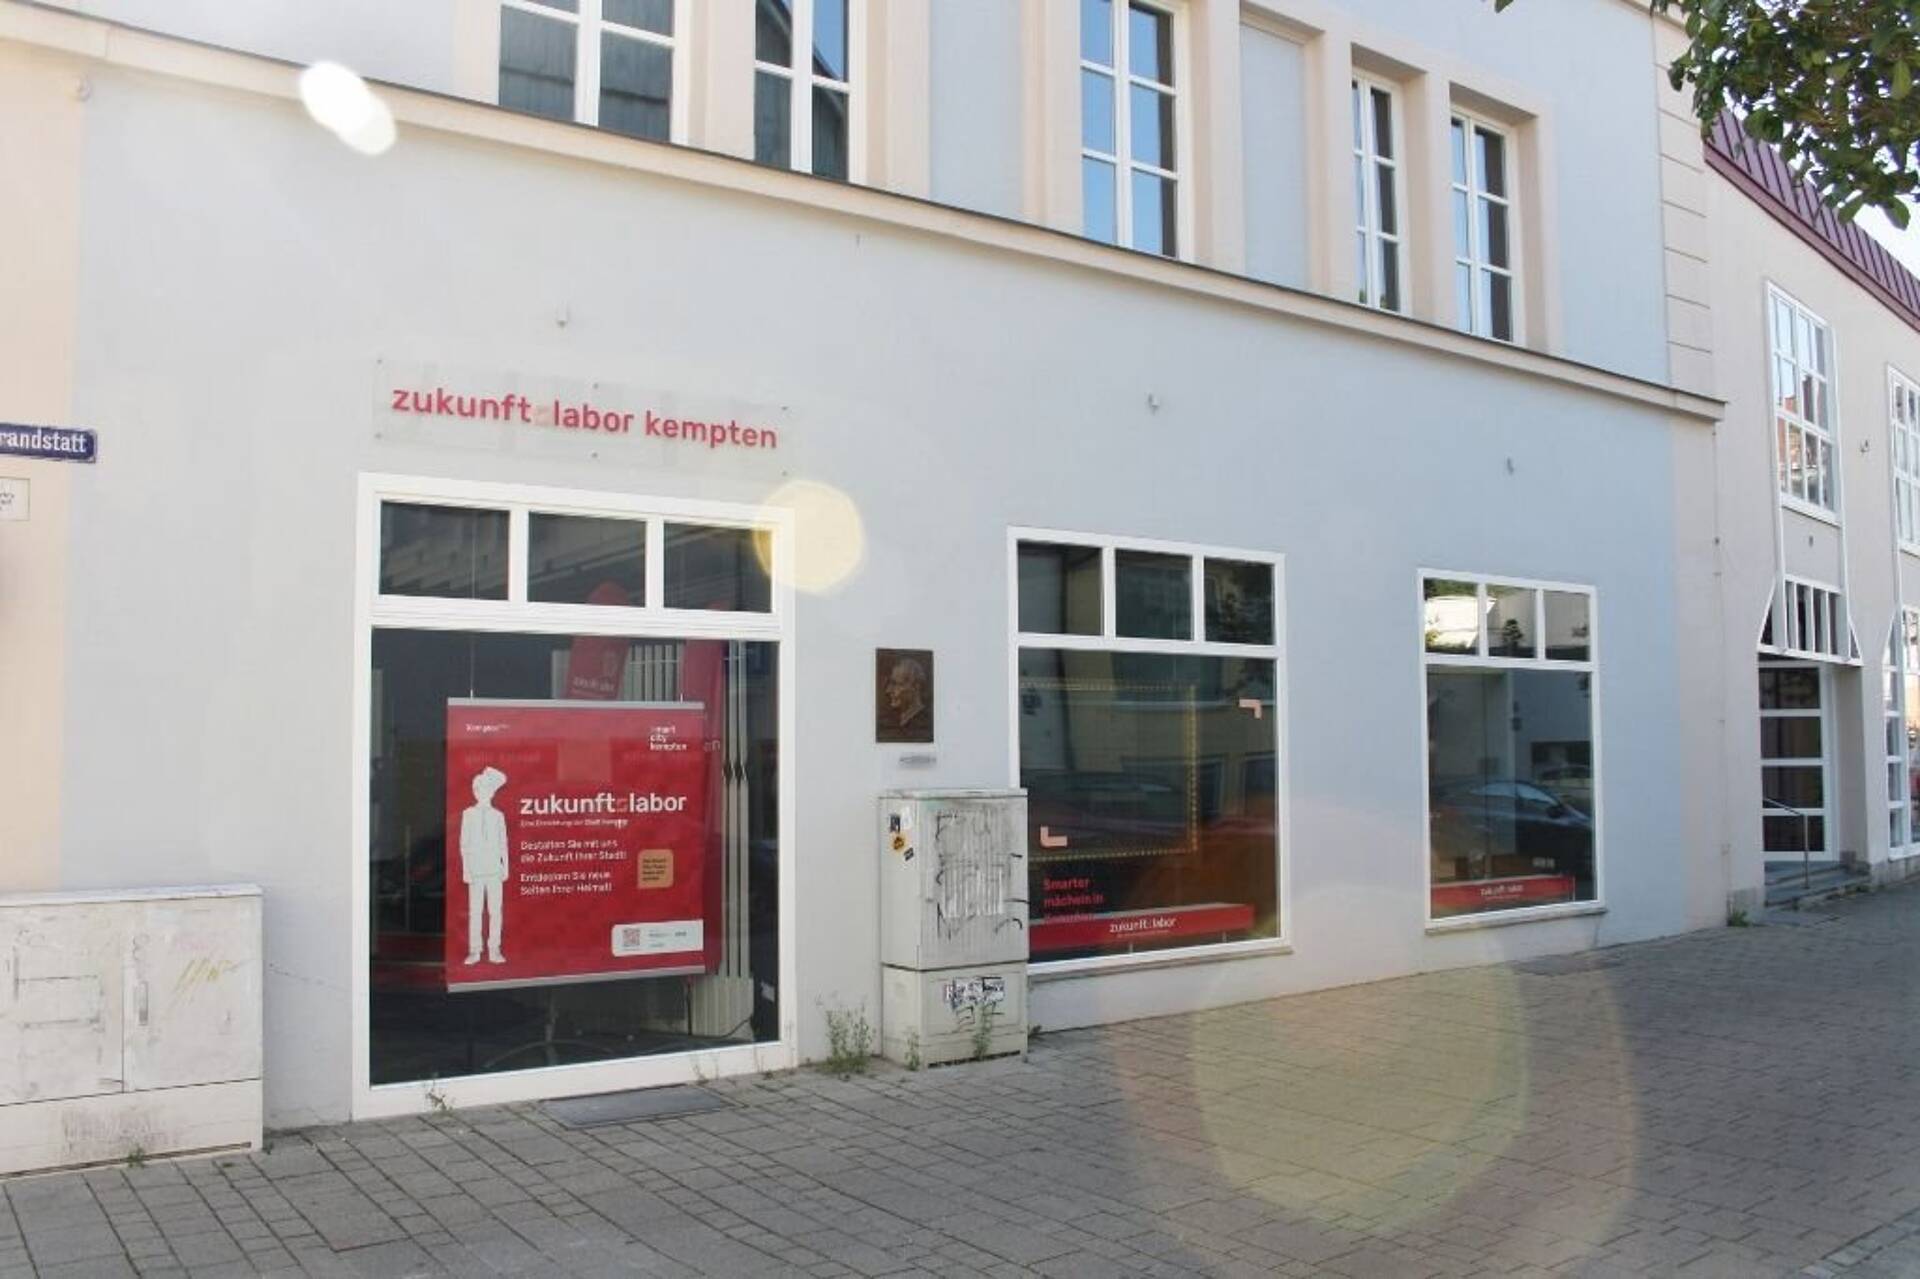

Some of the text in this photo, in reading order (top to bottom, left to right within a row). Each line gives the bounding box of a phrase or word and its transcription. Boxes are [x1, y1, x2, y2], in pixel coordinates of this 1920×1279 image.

[646, 410, 777, 449] kempten
[567, 839, 582, 849] Sie
[583, 839, 600, 848] mit
[537, 852, 573, 862] Zukunft
[1043, 877, 1090, 891] Smarter
